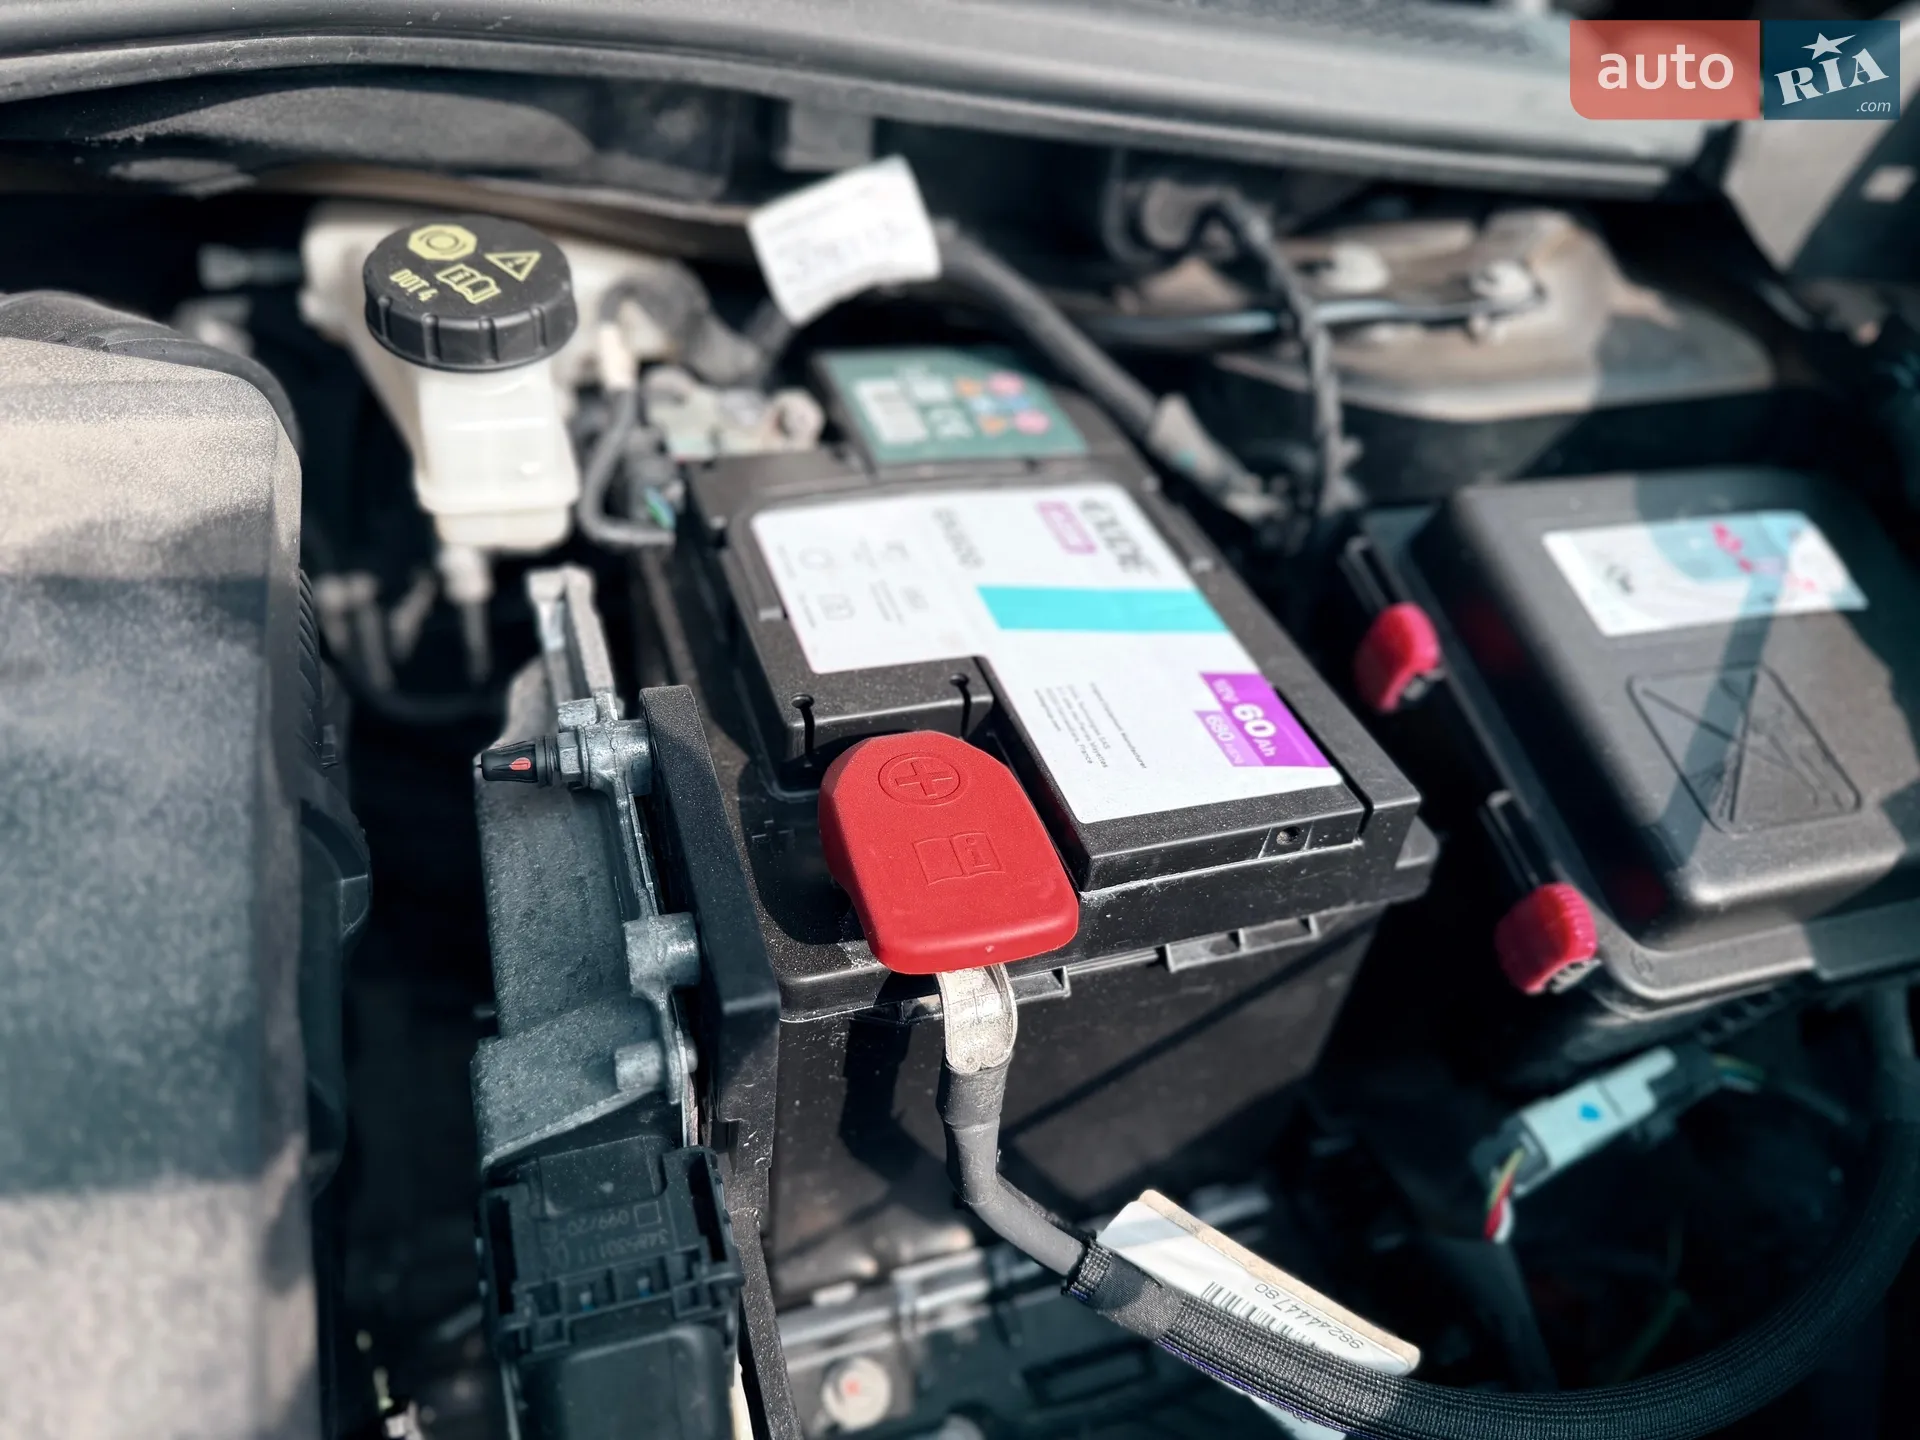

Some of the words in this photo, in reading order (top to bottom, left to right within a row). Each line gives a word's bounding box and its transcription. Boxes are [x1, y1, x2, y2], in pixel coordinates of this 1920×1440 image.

[389, 269, 430, 292] DOT
[418, 288, 438, 302] 4
[1078, 743, 1094, 764] France
